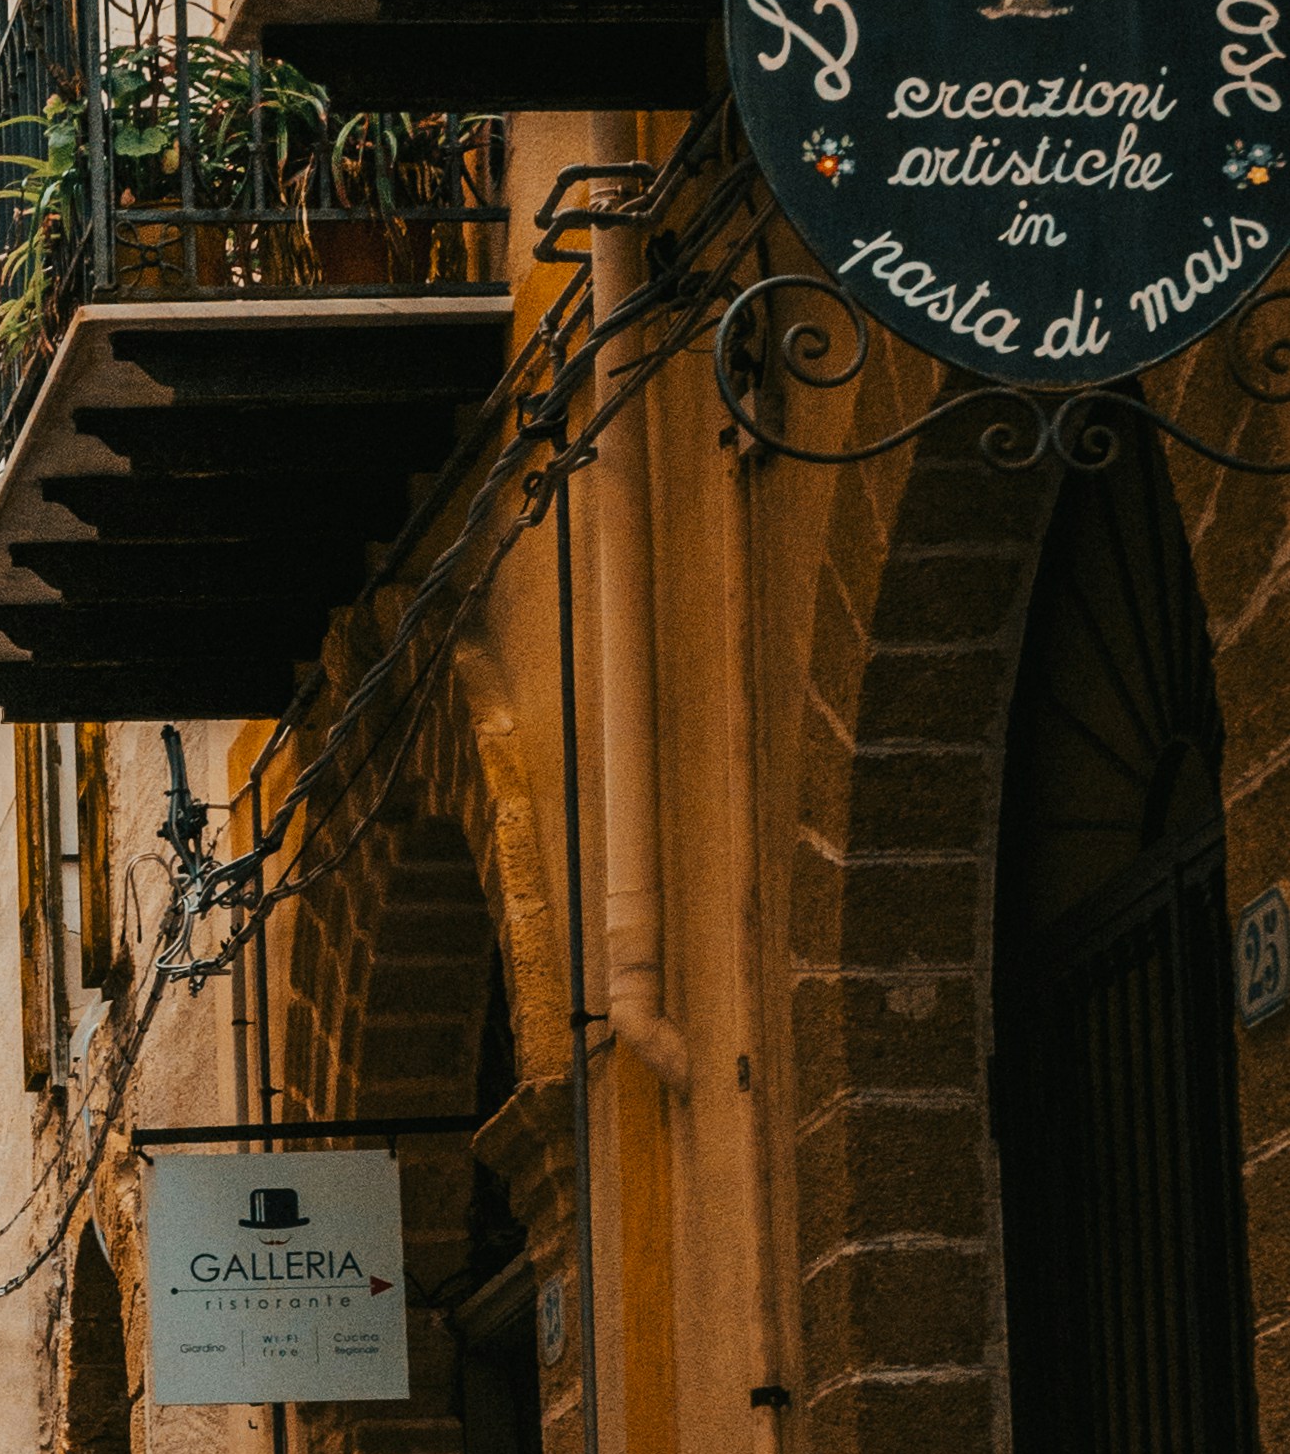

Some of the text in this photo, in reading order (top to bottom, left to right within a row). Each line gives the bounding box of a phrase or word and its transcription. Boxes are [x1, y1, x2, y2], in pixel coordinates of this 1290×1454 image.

[886, 64, 1178, 121] creazioni
[887, 123, 1173, 190] artistiche
[998, 200, 1068, 247] in
[838, 216, 1270, 359] pasta di mais
[1245, 908, 1280, 1003] 25
[190, 1250, 363, 1282] GALLERIA
[205, 1294, 351, 1310] ristorante
[180, 1343, 226, 1354] Giardino
[262, 1347, 298, 1357] free
[333, 1332, 380, 1343] Cucina
